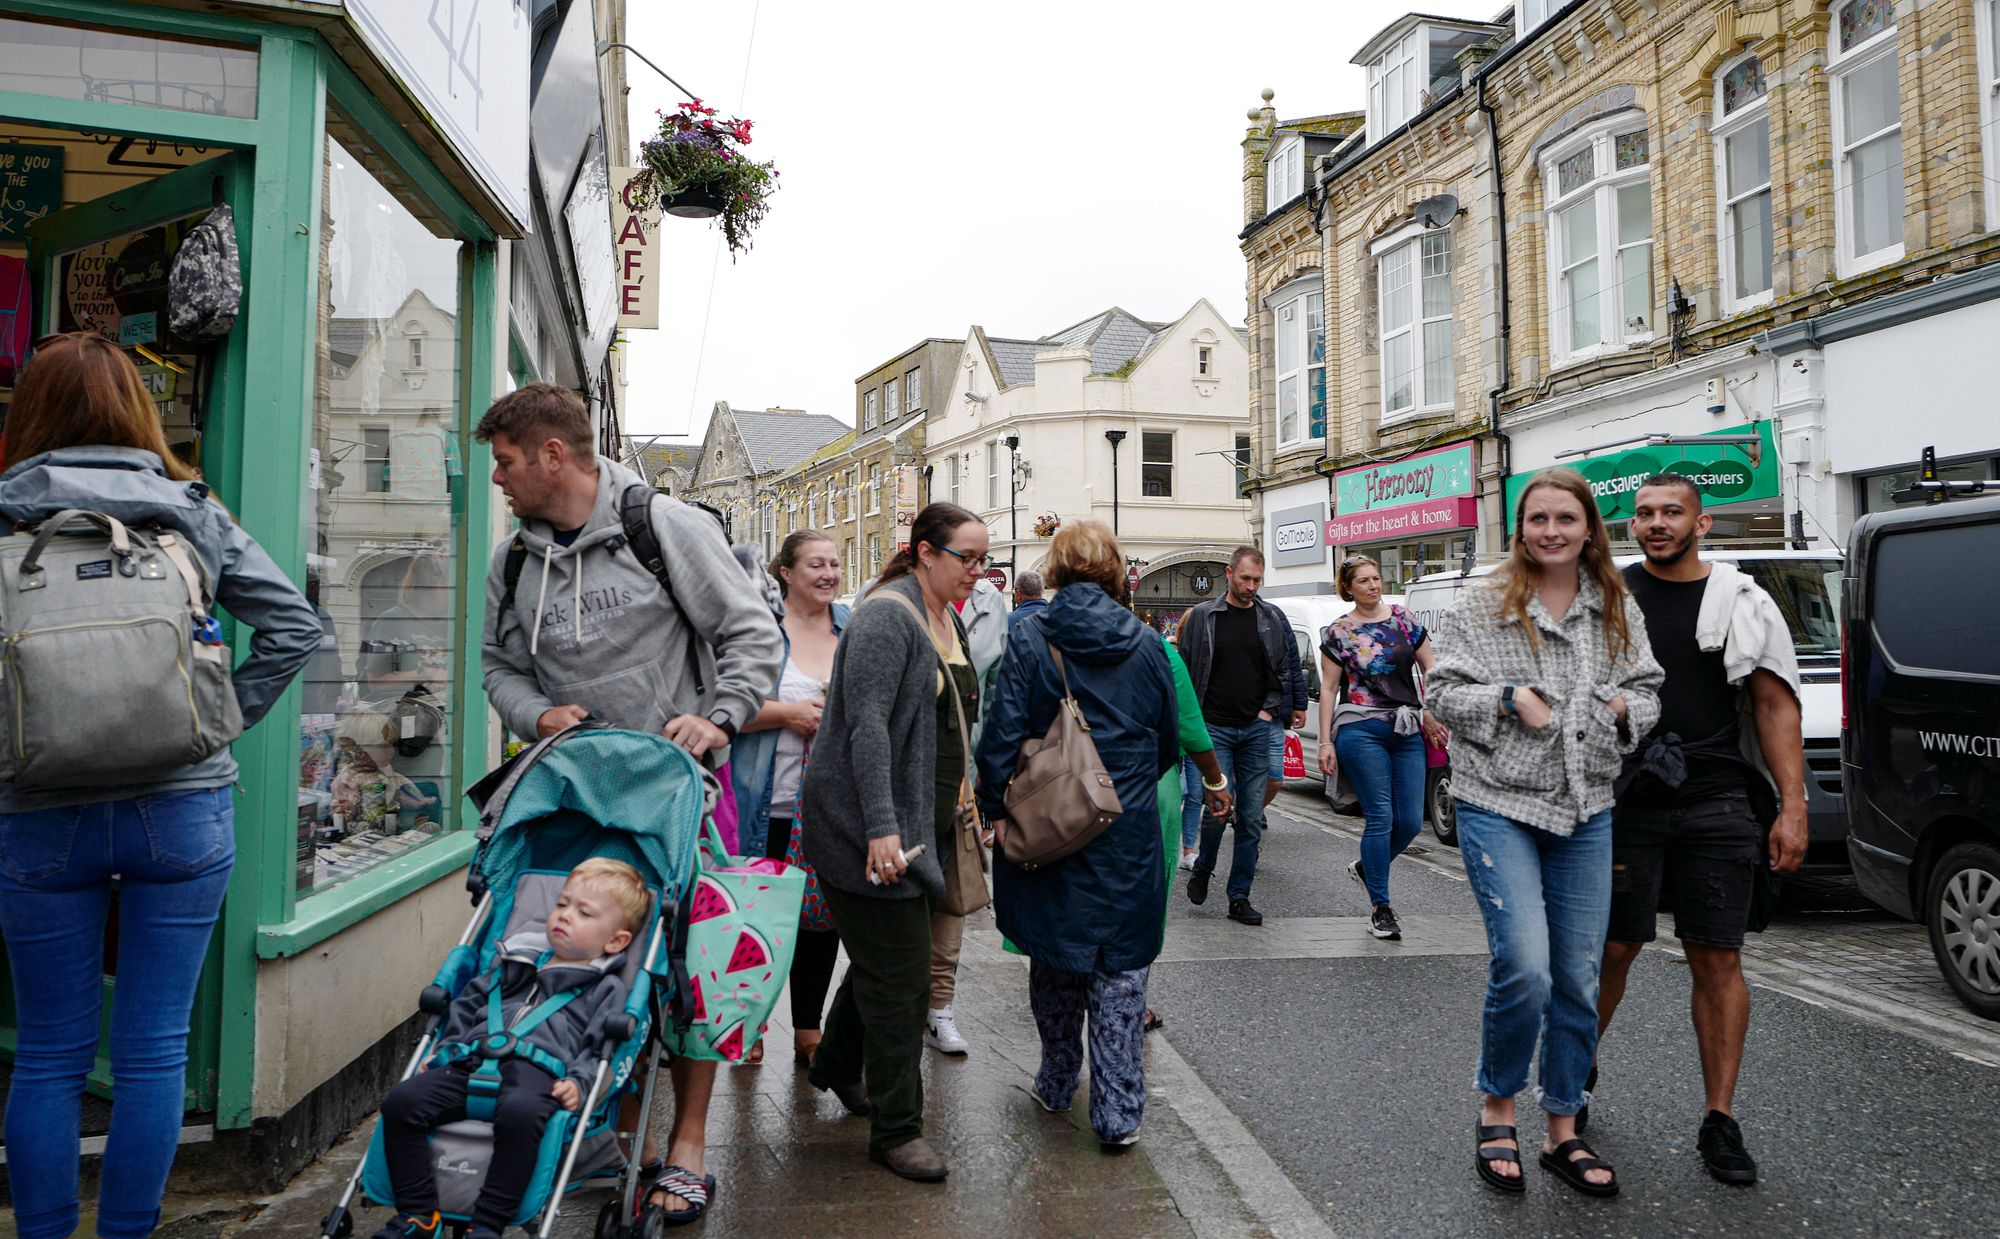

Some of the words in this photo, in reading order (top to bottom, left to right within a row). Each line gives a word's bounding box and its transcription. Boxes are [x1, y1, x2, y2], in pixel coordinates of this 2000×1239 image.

[21, 155, 51, 172] you
[4, 172, 28, 187] THE
[75, 252, 113, 272] love
[70, 273, 107, 294] you
[77, 291, 88, 301] to
[73, 302, 115, 316] moon
[122, 320, 153, 338] WE'RE
[1365, 464, 1434, 510] Harmony
[1587, 471, 1651, 498] pecsavers
[1329, 523, 1349, 541] Gifts
[1350, 521, 1364, 538] for
[1366, 519, 1381, 534] the
[1382, 514, 1408, 532] heart
[1410, 510, 1420, 526] &
[1422, 508, 1452, 524] home
[1278, 527, 1315, 546] GoMobile
[531, 603, 568, 629] Jck
